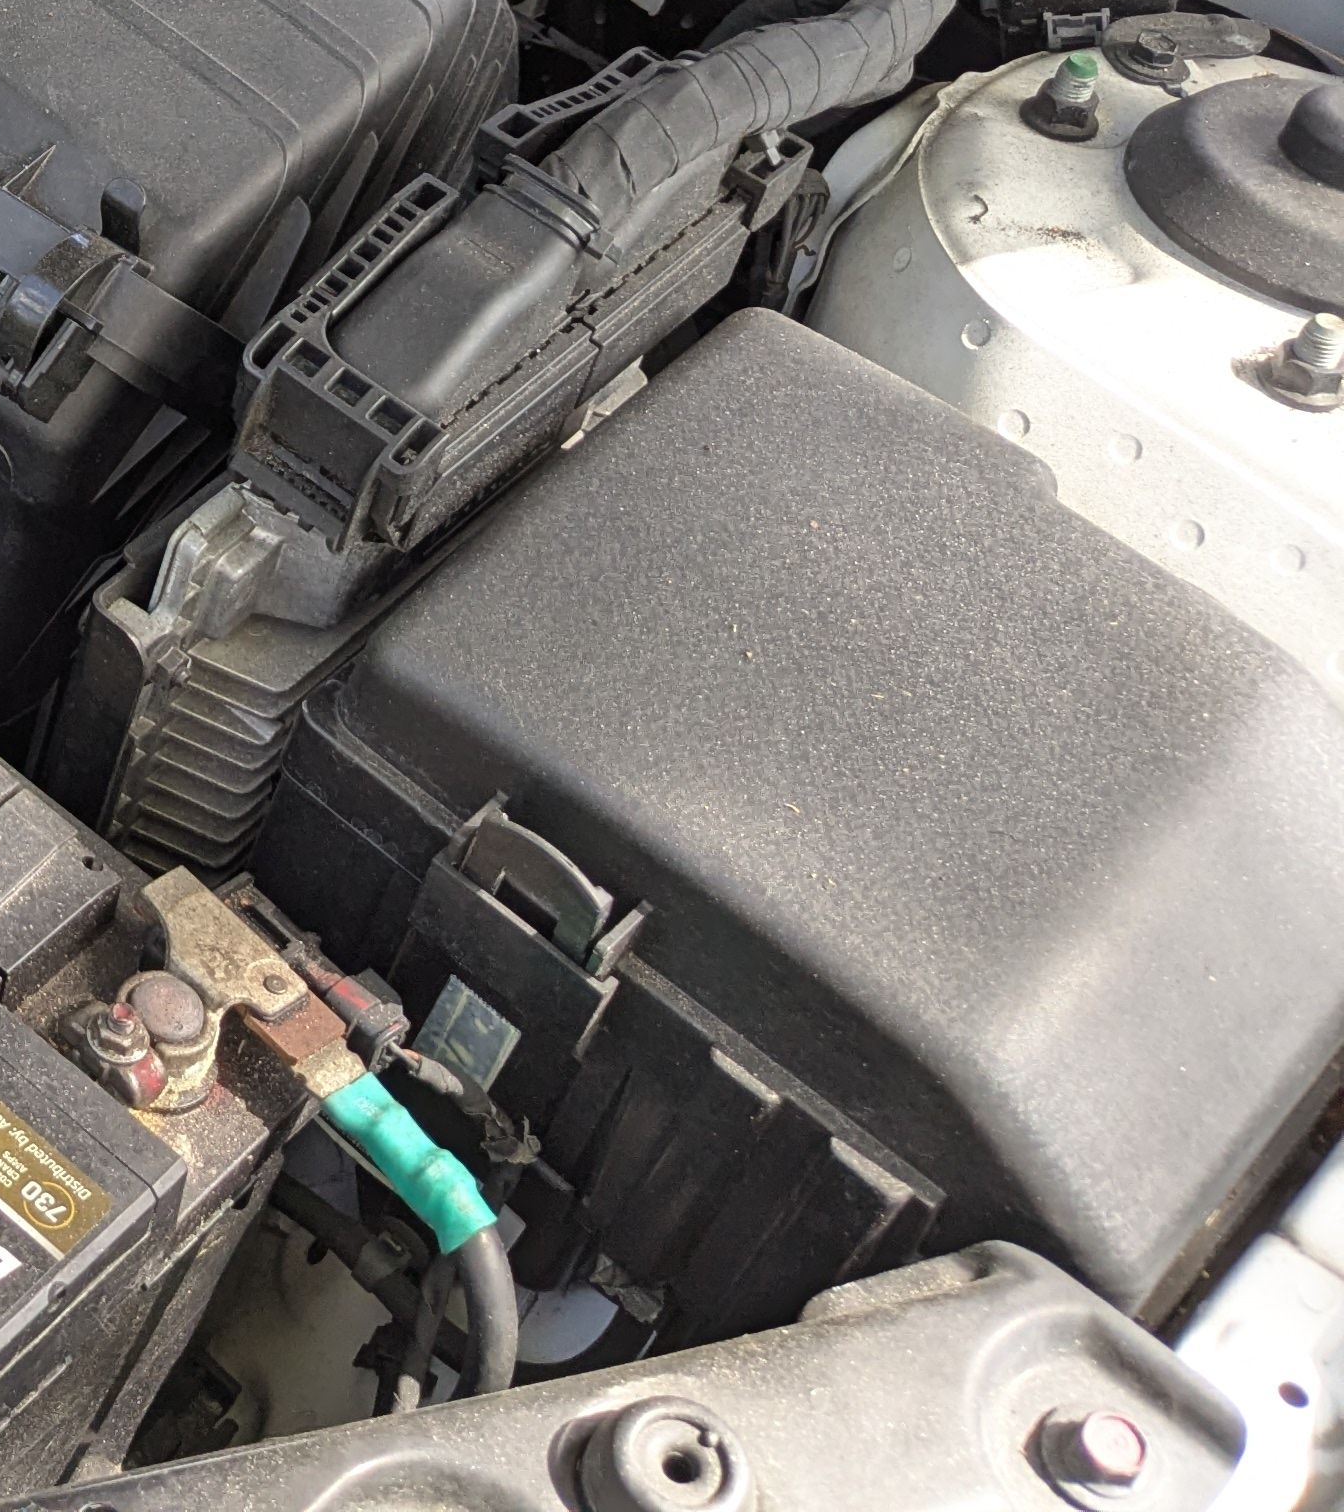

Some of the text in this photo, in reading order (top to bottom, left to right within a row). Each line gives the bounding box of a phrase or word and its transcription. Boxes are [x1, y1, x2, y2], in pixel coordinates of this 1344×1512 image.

[5, 1125, 31, 1147] by:
[0, 1148, 29, 1174] AMPS
[22, 1142, 93, 1200] Distributed
[17, 1178, 69, 1223] 730
